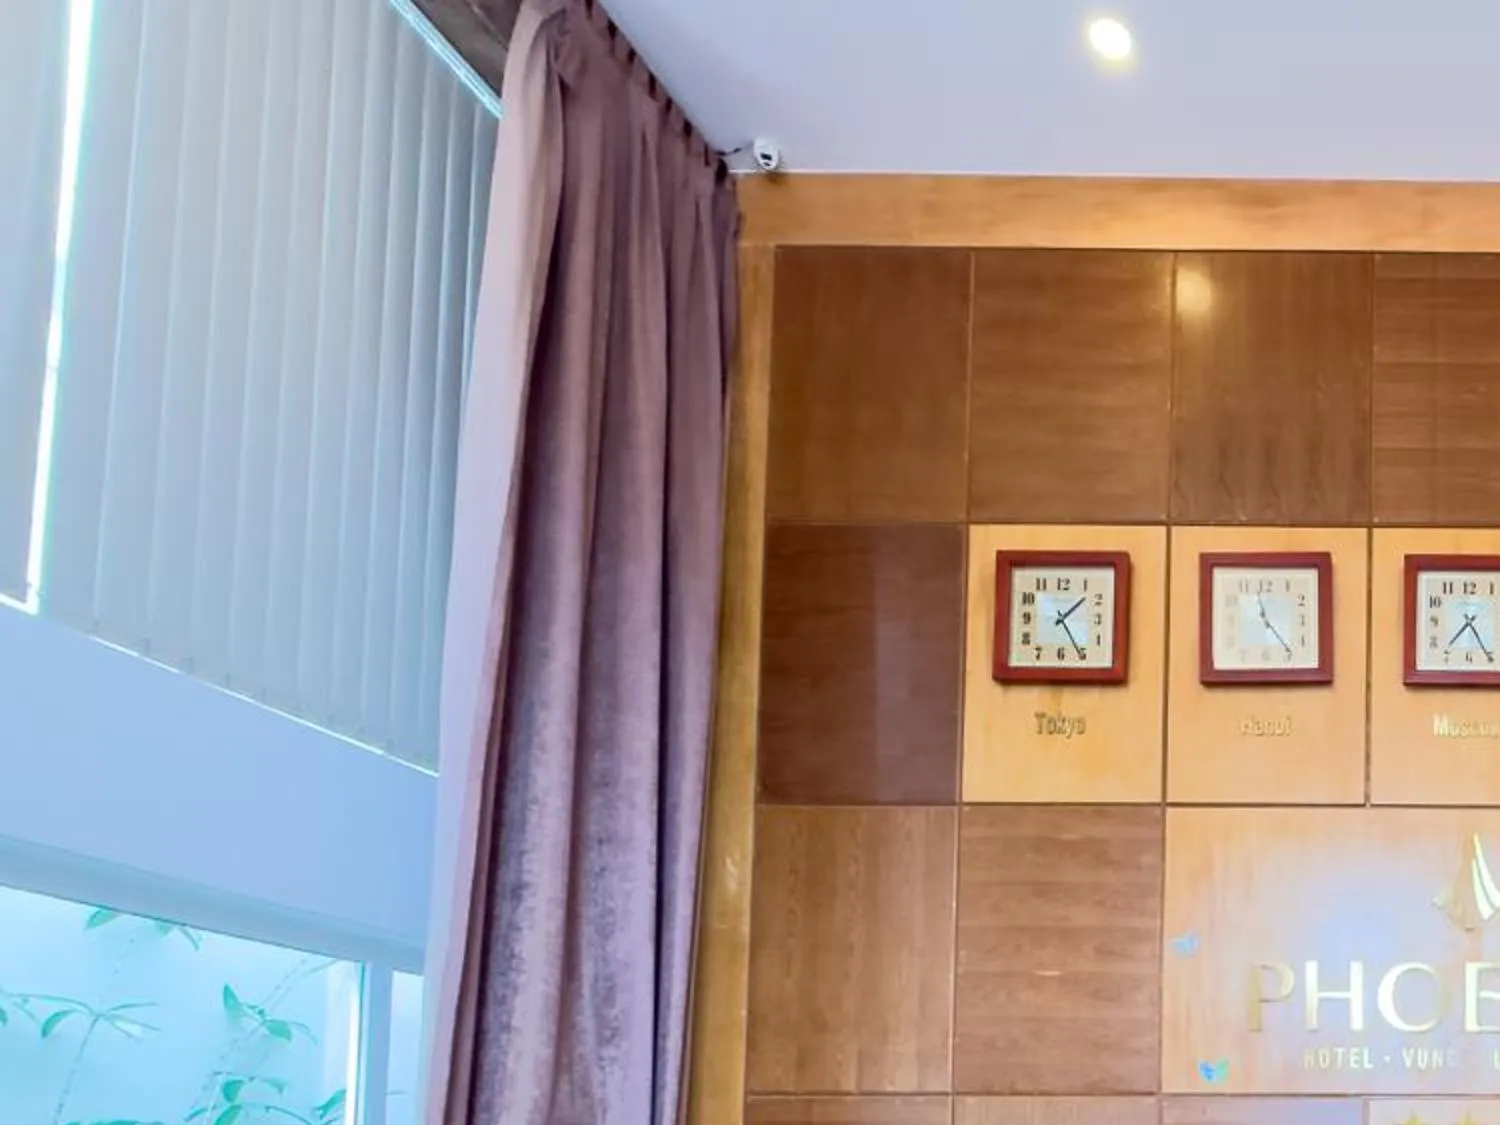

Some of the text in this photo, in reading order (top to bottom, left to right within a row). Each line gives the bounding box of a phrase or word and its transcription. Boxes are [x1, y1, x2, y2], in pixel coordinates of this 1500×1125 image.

[1035, 577, 1047, 591] 11
[1057, 577, 1070, 591] 12
[1443, 581, 1453, 595] 11
[1463, 582, 1477, 595] 12
[1022, 592, 1035, 605] 10
[1429, 596, 1442, 609] 10
[1022, 611, 1031, 625] 9
[1034, 647, 1043, 661] 7
[1056, 647, 1066, 661] 6
[1033, 711, 1087, 740] Tokyo
[1303, 1047, 1374, 1070] HOTEL
